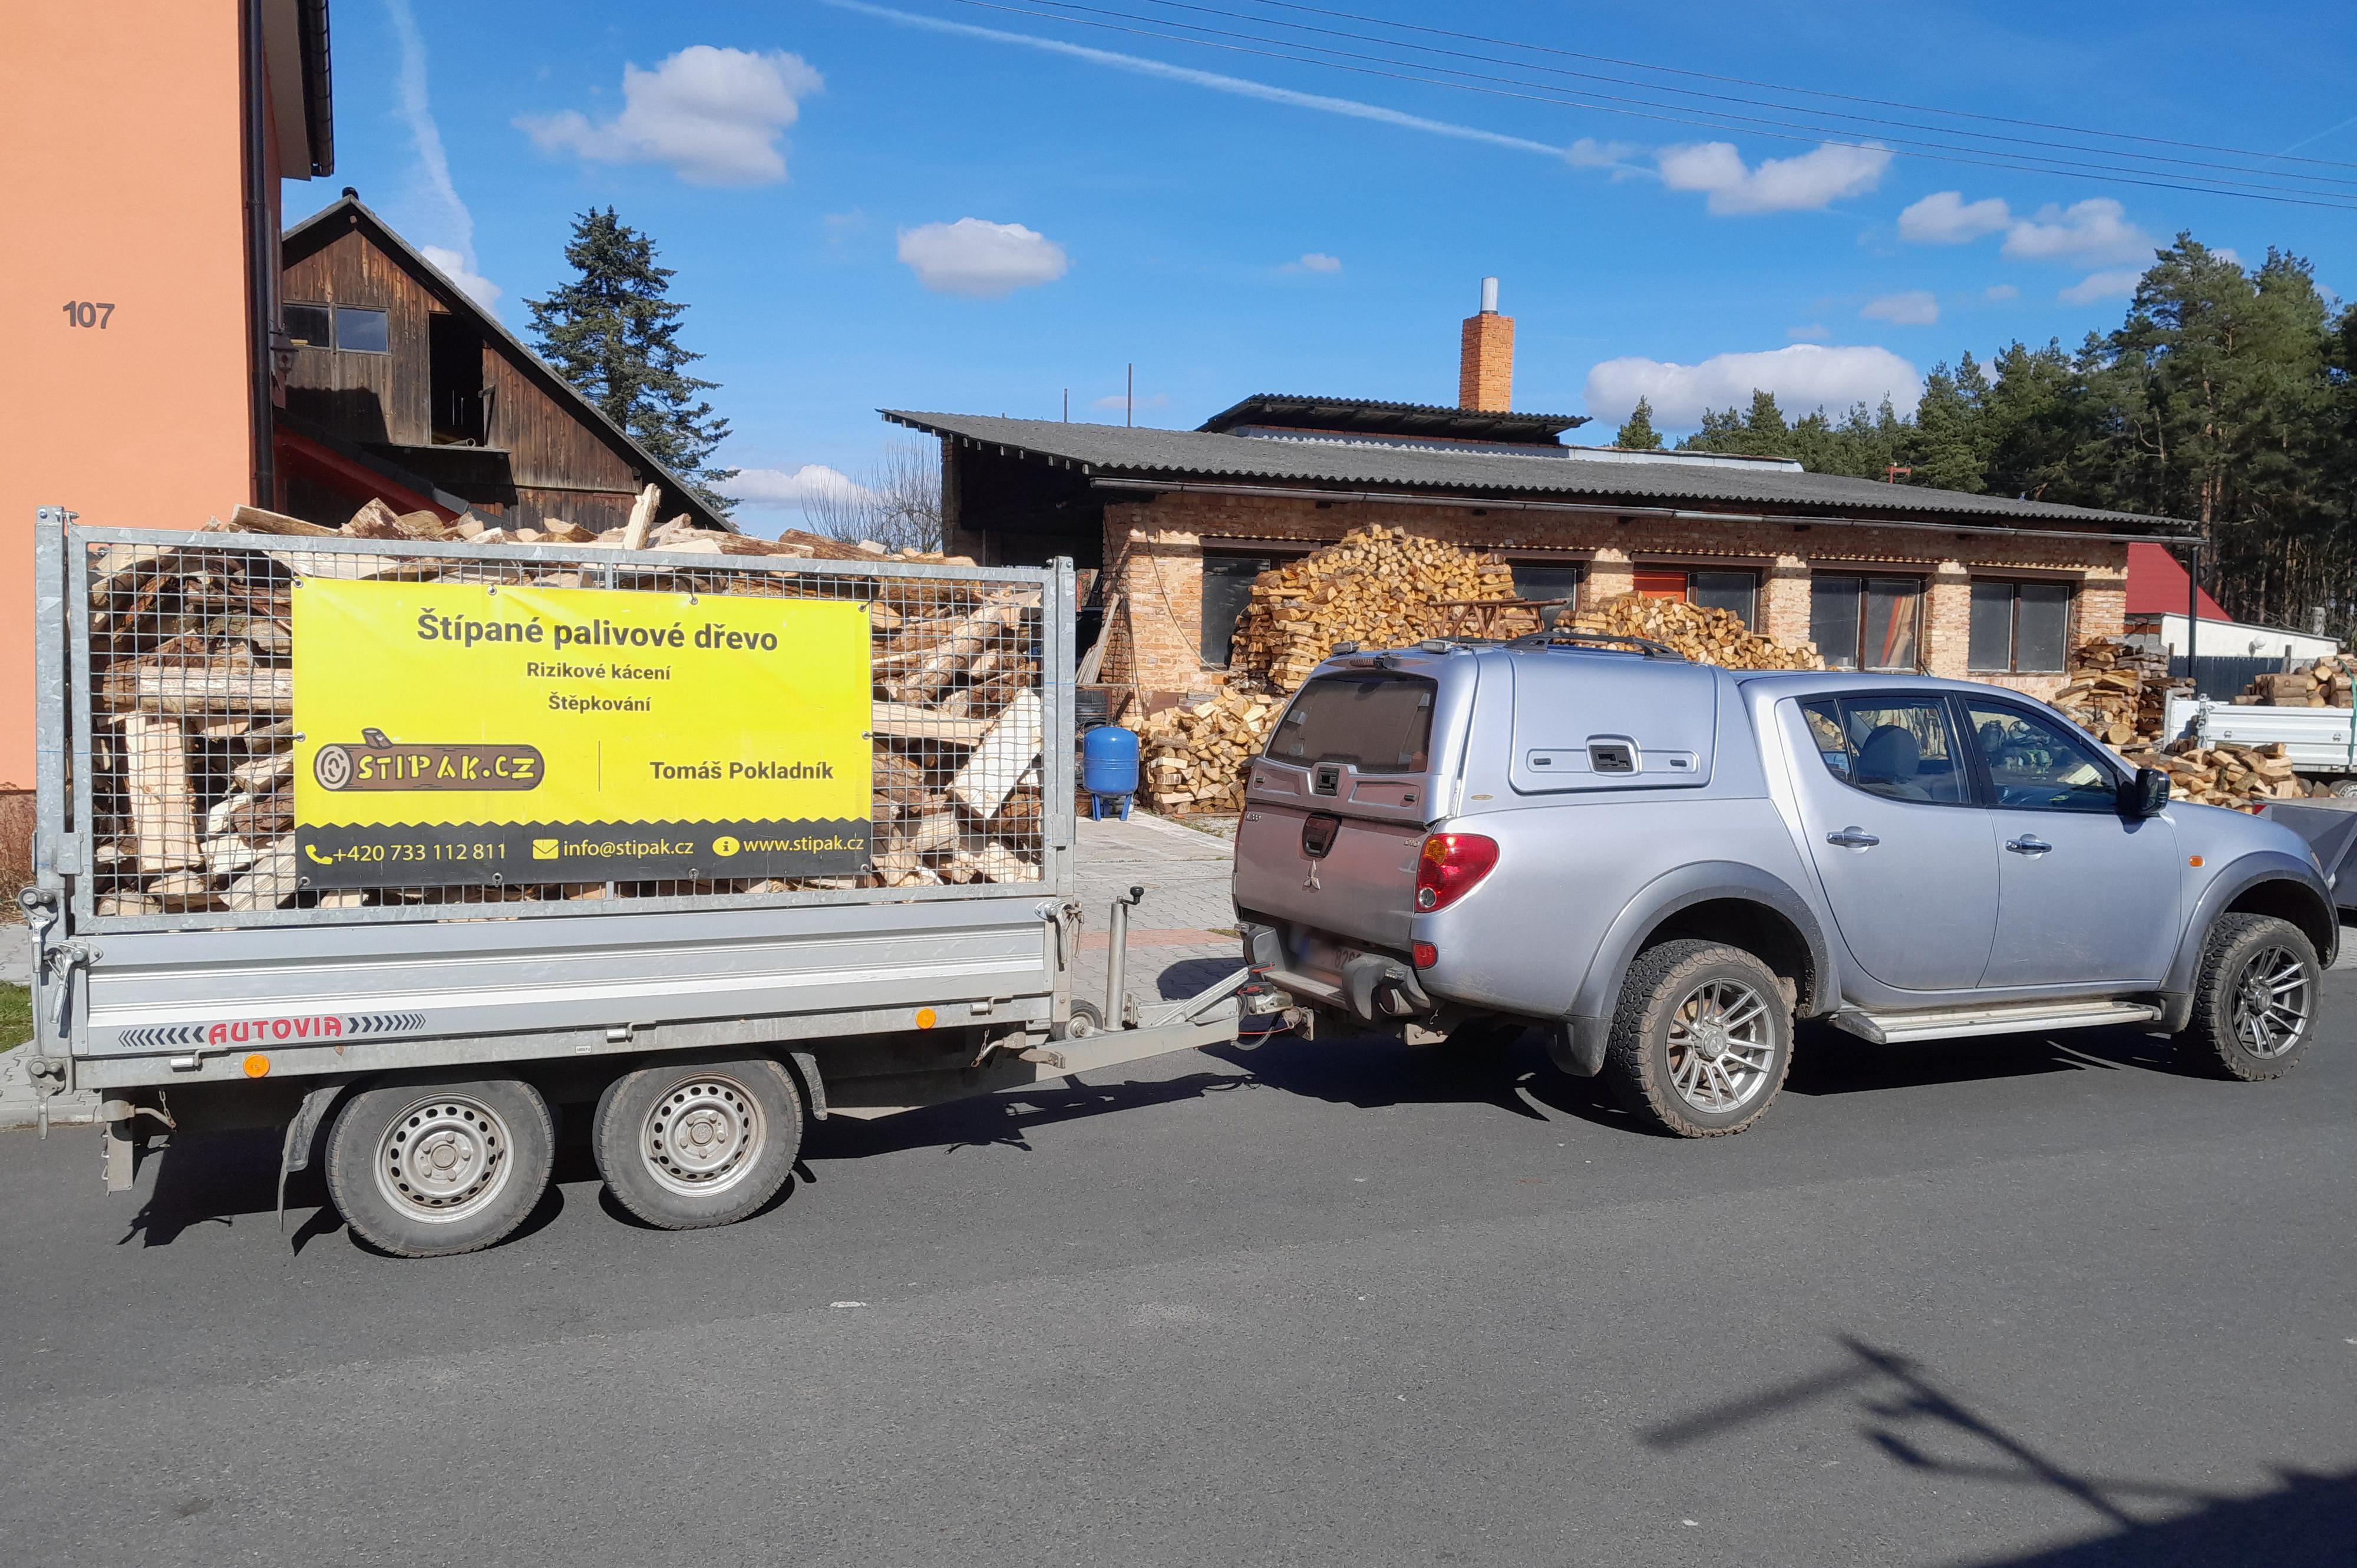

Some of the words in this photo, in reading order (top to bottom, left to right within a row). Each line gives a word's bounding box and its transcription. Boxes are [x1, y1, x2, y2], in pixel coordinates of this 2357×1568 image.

[62, 300, 115, 329] 107
[417, 608, 543, 648] Štípané
[554, 619, 685, 651] palivové
[695, 623, 778, 651] dřevo
[527, 662, 606, 678] Rizikové
[611, 663, 671, 680] kácení
[548, 691, 651, 714] Štěpkování
[357, 754, 536, 781] STIPAK.CZ
[649, 761, 722, 780] Tomáš
[729, 761, 834, 780] Pokladník
[333, 844, 385, 862] +420
[390, 844, 425, 861] 733
[433, 843, 466, 860] 112
[473, 843, 506, 860] 811
[563, 838, 694, 859] info@stipak.cz
[743, 834, 864, 854] www.stipak.cz
[209, 1016, 342, 1046] AUTOVIA
